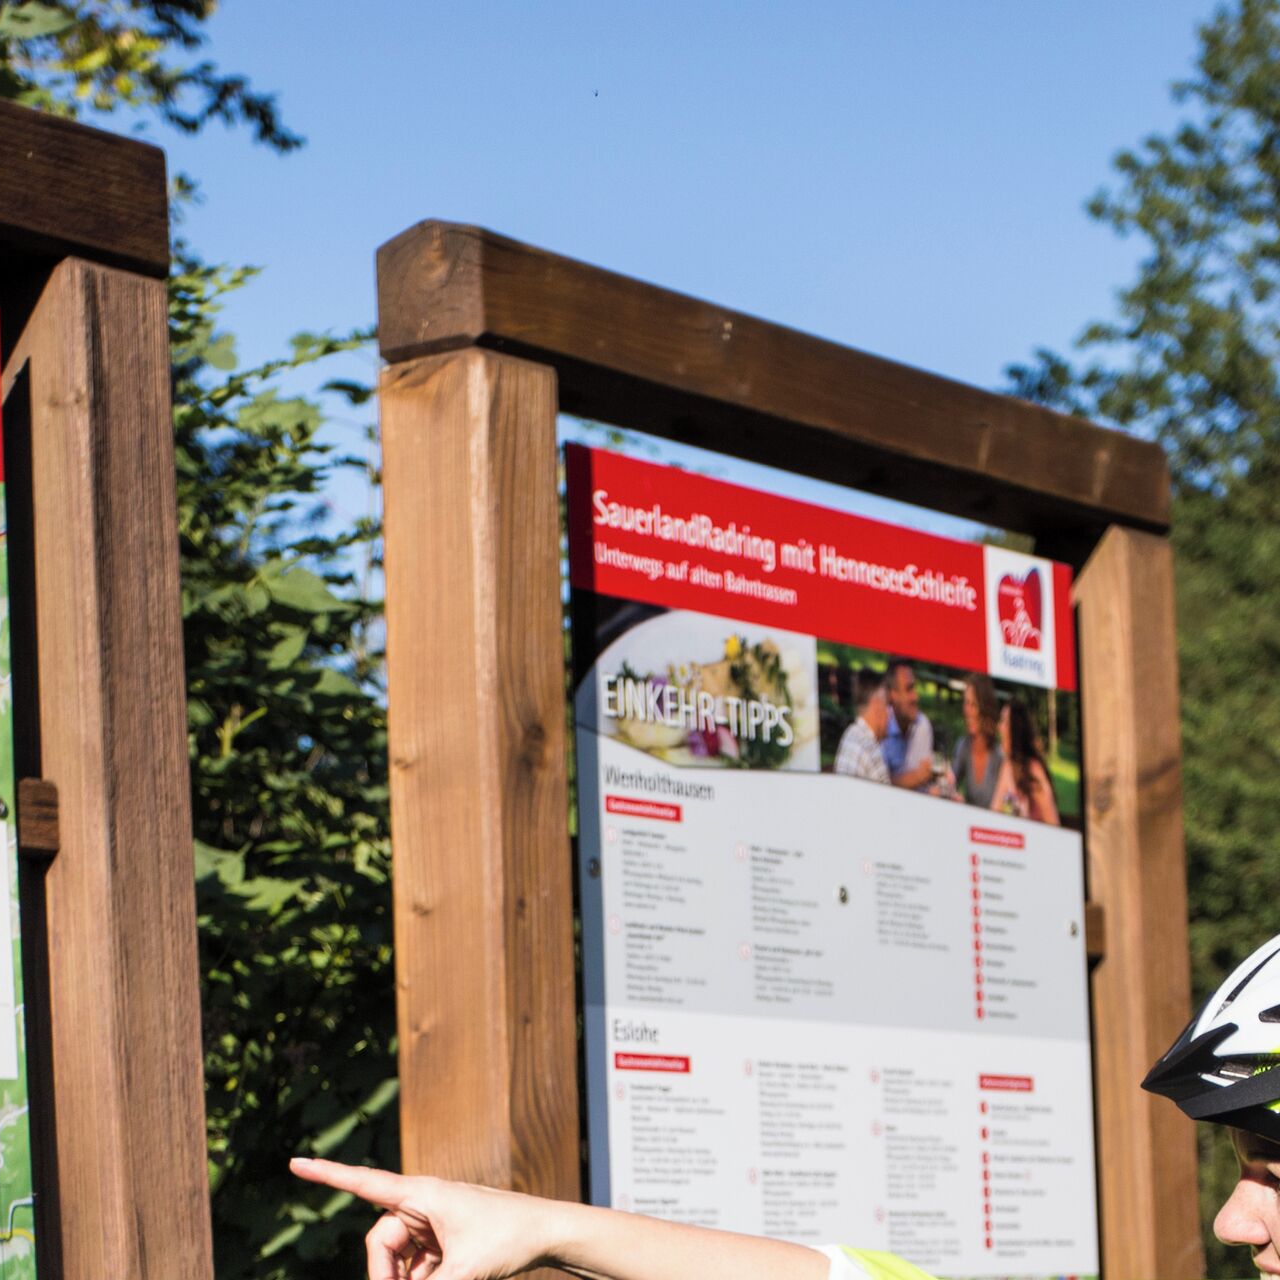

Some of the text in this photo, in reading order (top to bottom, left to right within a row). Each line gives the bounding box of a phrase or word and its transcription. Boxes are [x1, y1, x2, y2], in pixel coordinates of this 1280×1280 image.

[594, 490, 978, 611] SauerlandRadring mit HenneseeSchleife
[595, 543, 798, 605] Unterwegs auf alten Bahntrassen
[602, 673, 794, 747] EINKEHR-TIPPS
[605, 766, 715, 801] Wenholthausen
[613, 1018, 660, 1044] Eslohe
